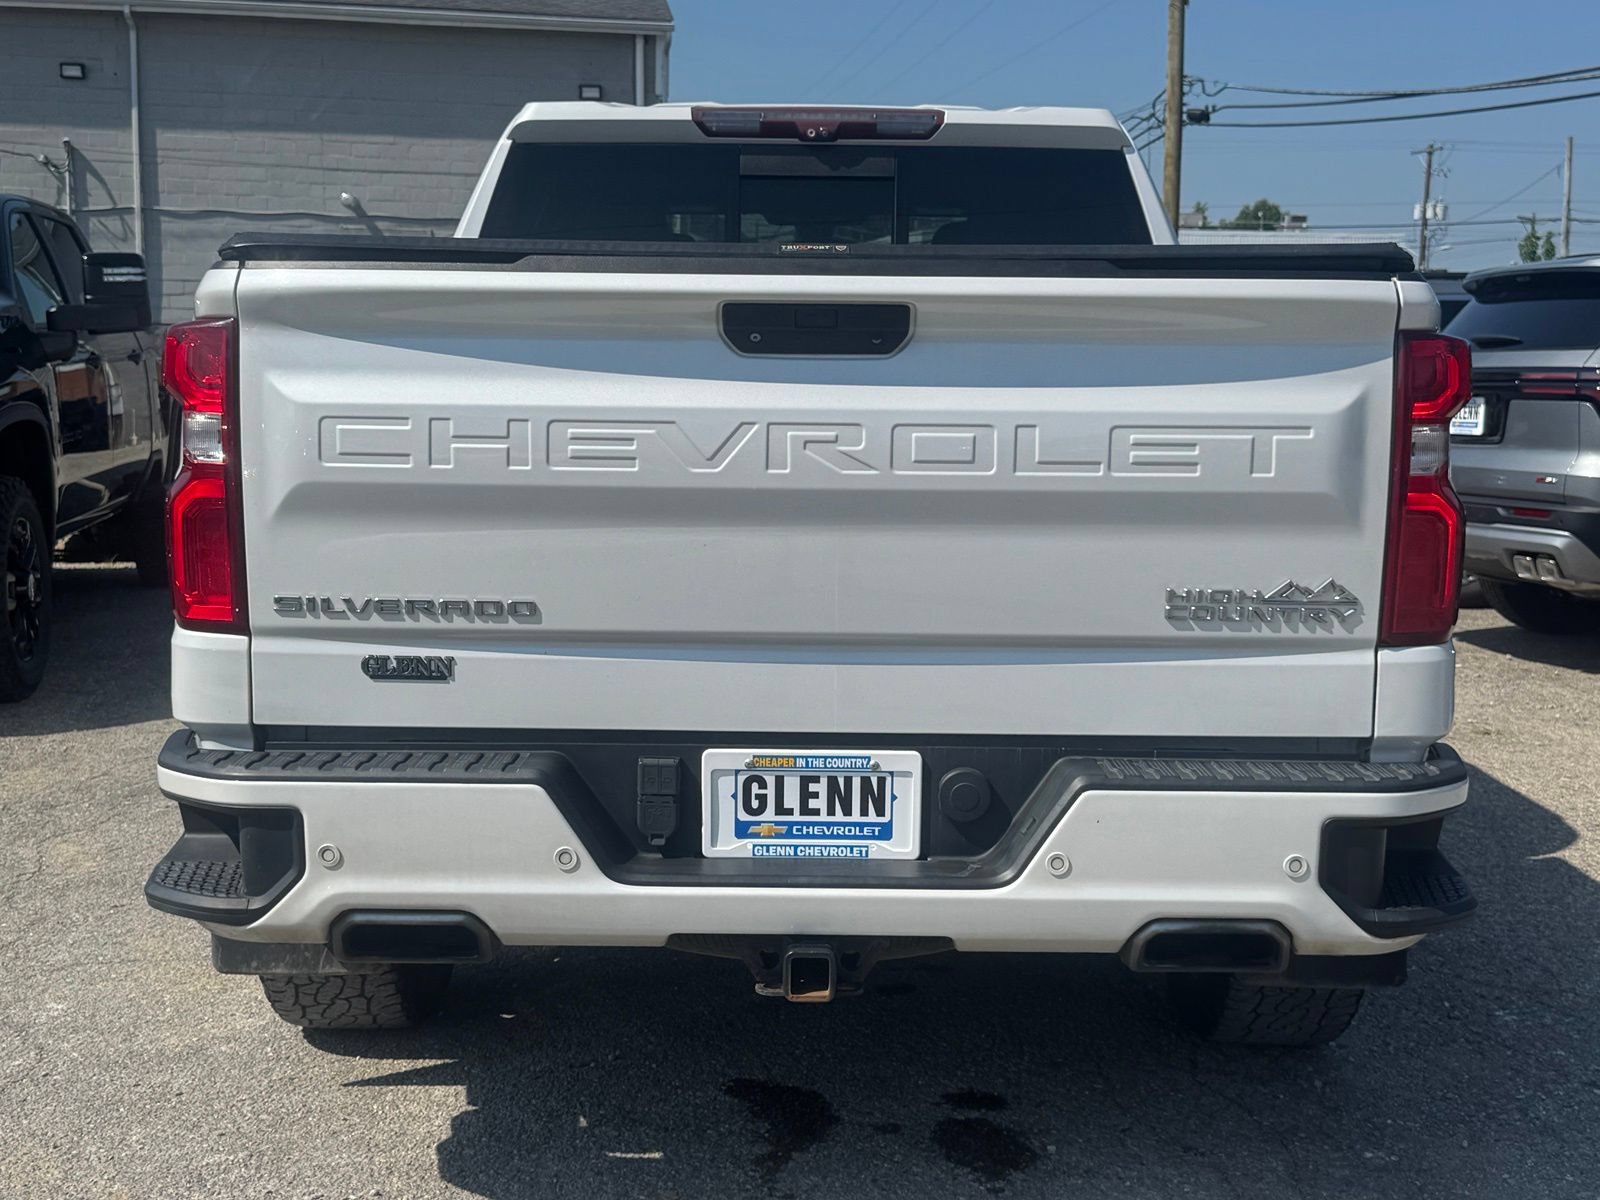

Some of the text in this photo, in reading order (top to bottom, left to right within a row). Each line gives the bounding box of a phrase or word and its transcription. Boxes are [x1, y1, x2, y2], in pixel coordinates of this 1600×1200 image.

[318, 415, 1314, 478] CHEVROLET
[273, 593, 537, 617] SILVERADO
[1165, 605, 1358, 624] COUNTRY
[361, 655, 455, 680] GLENN
[753, 757, 794, 768] CHEAPER
[796, 757, 806, 768] IN
[807, 757, 825, 768] THE
[742, 774, 886, 817] GLENN
[792, 825, 881, 836] CHEVROLET
[754, 845, 868, 857] GLENN CHEVROLET
